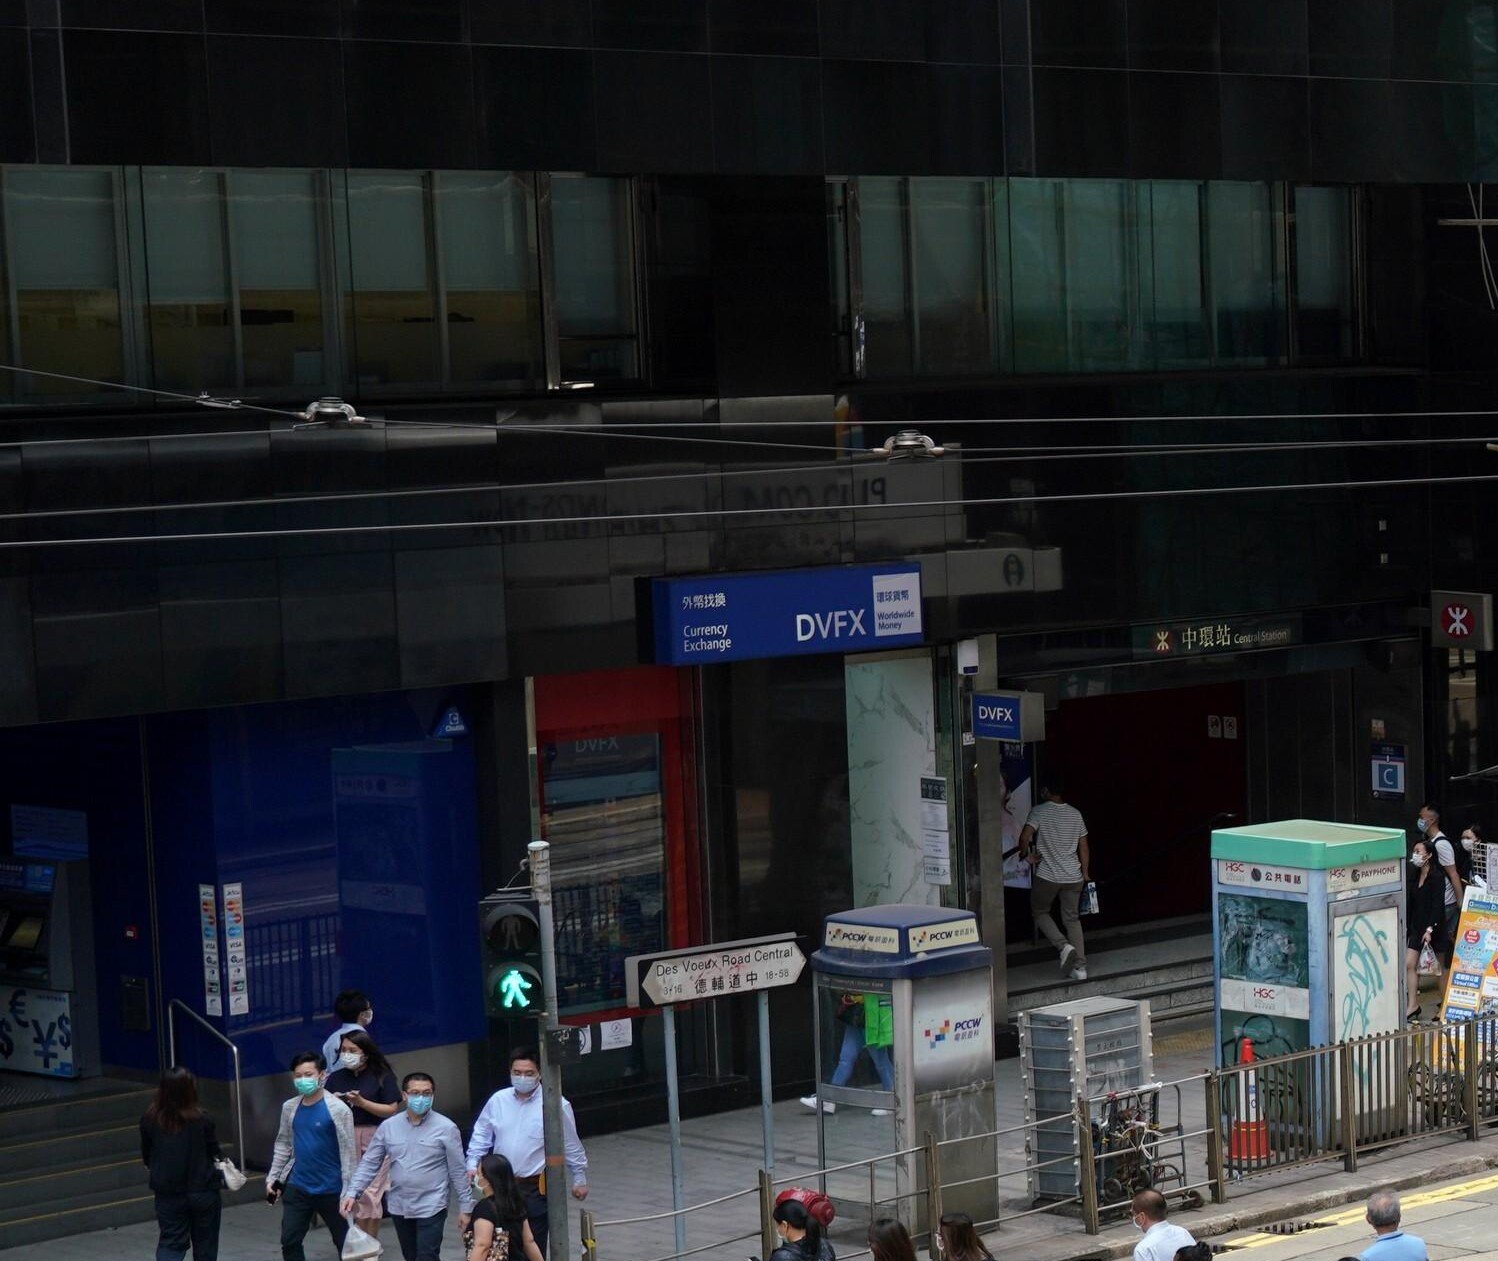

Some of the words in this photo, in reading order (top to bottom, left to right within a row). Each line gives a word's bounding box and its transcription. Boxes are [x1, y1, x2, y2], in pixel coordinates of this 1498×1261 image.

[877, 609, 916, 621] Worldwide
[683, 623, 729, 639] Currency
[795, 608, 867, 643] DVFX
[877, 621, 903, 631] Money
[1181, 624, 1232, 651] 中環站
[1233, 631, 1261, 645] Central
[1261, 628, 1289, 642] Station
[683, 637, 733, 653] Exchange
[978, 705, 1014, 723] DVFX
[1225, 862, 1245, 873] HGC
[1361, 866, 1397, 879] PAYPHONE
[1264, 871, 1302, 885] 公共電話
[841, 932, 868, 942] PCCW
[929, 930, 953, 942] PCCW
[656, 964, 679, 977] Des
[682, 958, 718, 973] Voeux
[721, 953, 751, 968] Road
[754, 946, 794, 962] Central
[694, 970, 759, 995] 德輔道中
[1253, 987, 1275, 1000] HGC
[953, 1017, 982, 1032] PCCW
